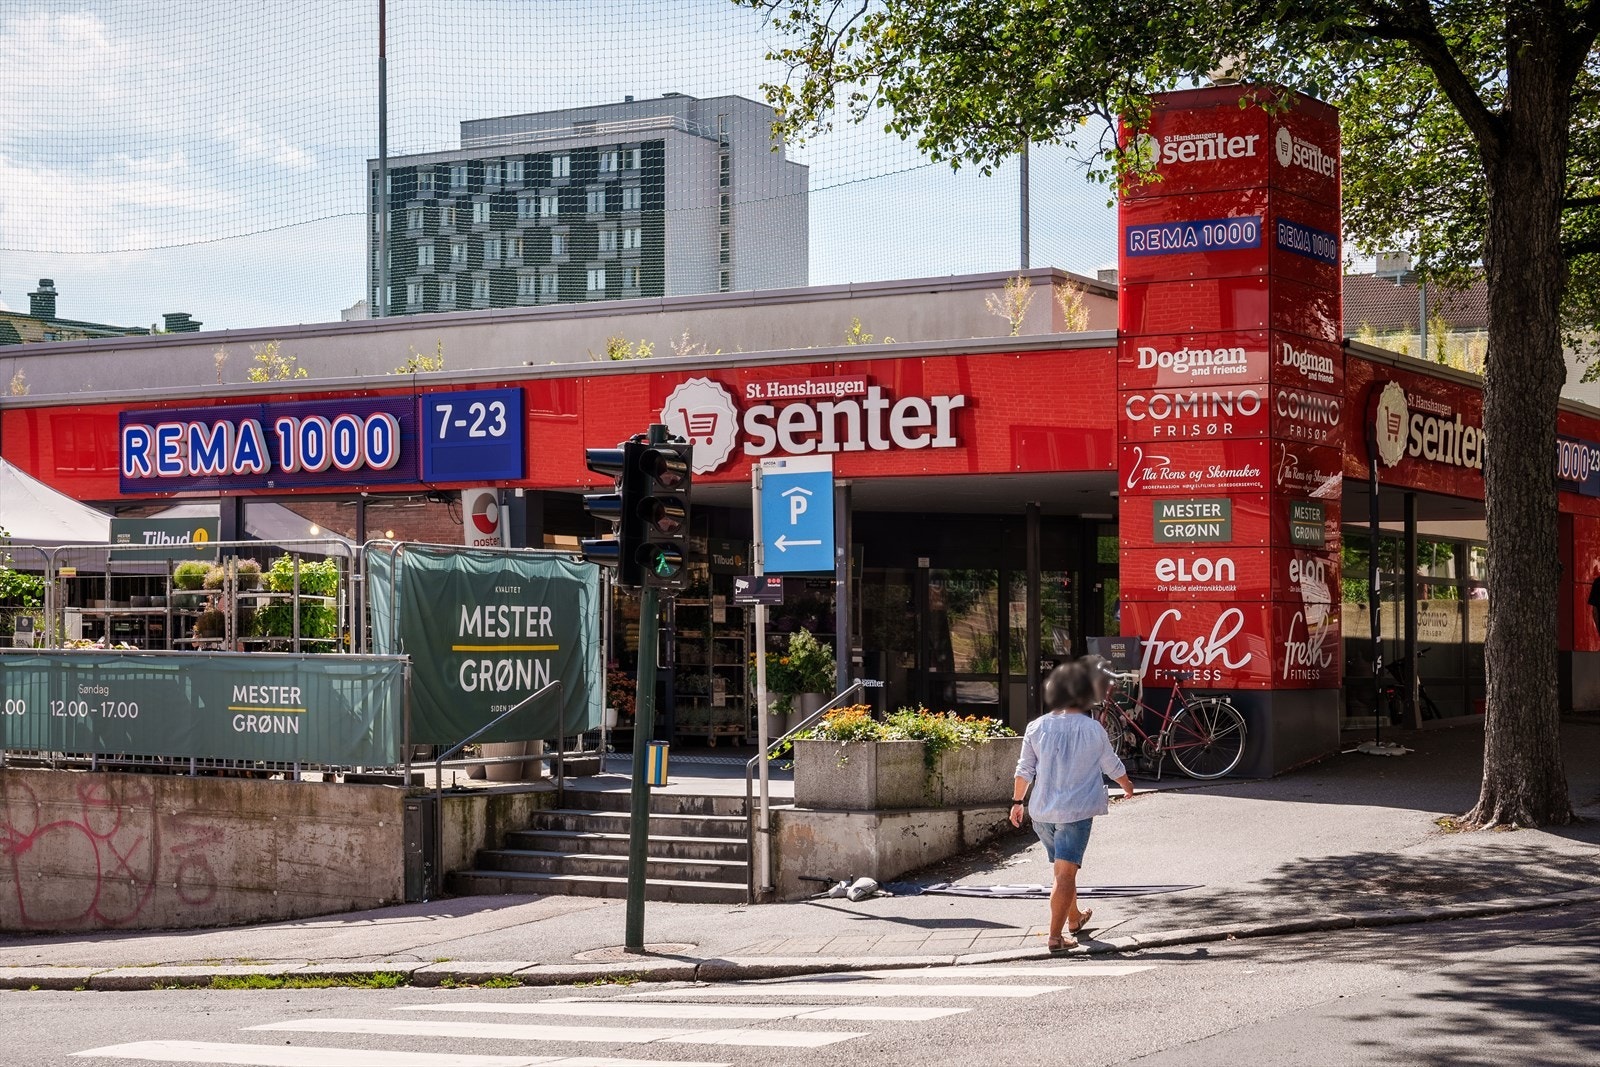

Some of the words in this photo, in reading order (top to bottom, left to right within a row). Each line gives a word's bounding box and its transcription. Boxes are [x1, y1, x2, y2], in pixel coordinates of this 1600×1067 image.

[1164, 135, 1173, 143] St.
[1173, 132, 1217, 142] Hanshaugen
[1163, 133, 1260, 165] senter
[1293, 144, 1337, 178] senter
[1130, 227, 1198, 251] REMA
[1203, 222, 1256, 247] 1000
[1278, 223, 1311, 251] REMA
[1312, 232, 1336, 260] 1000
[1137, 347, 1248, 374] Dogman
[1283, 343, 1334, 375] Dogman
[1191, 366, 1211, 376] and
[1212, 364, 1247, 376] friends
[1308, 372, 1318, 381] and
[1318, 373, 1334, 384] friends
[746, 383, 764, 398] St.
[766, 380, 865, 397] Hanshaugen
[1125, 389, 1262, 421] COMINO
[1277, 390, 1340, 426] COMINO
[1407, 393, 1415, 407] St.
[1415, 395, 1452, 417] Hanshaugen
[436, 401, 507, 439] 7-23
[743, 386, 965, 456] senter
[1153, 423, 1233, 437] FRISØR
[1290, 425, 1327, 441] FRISØR
[123, 418, 270, 479] REMA
[275, 412, 400, 474] 1000
[1160, 467, 1187, 480] Rens
[1189, 469, 1204, 482] og
[1206, 464, 1261, 479] Skomaker
[789, 495, 808, 525] P
[1162, 503, 1222, 518] MESTER
[1294, 506, 1321, 520] MESTER
[143, 531, 191, 545] Tilbud
[1163, 524, 1220, 538] GRØNN
[1294, 526, 1320, 540] GRØNN
[712, 554, 735, 566] Tilbud
[1187, 584, 1237, 592] elektronikkbutikk
[458, 604, 554, 638] MESTER
[1139, 607, 1252, 679] fresh
[1283, 610, 1332, 680] fresh
[459, 658, 551, 693] GRØNN
[862, 680, 885, 688] senter
[1290, 669, 1320, 680] FITNESS
[78, 684, 110, 696] Søndag
[232, 685, 302, 705] MESTER
[50, 701, 88, 718] 12.00
[100, 701, 139, 719] 17.00
[490, 704, 507, 712] SIDEN
[232, 714, 299, 734] GRØNN
